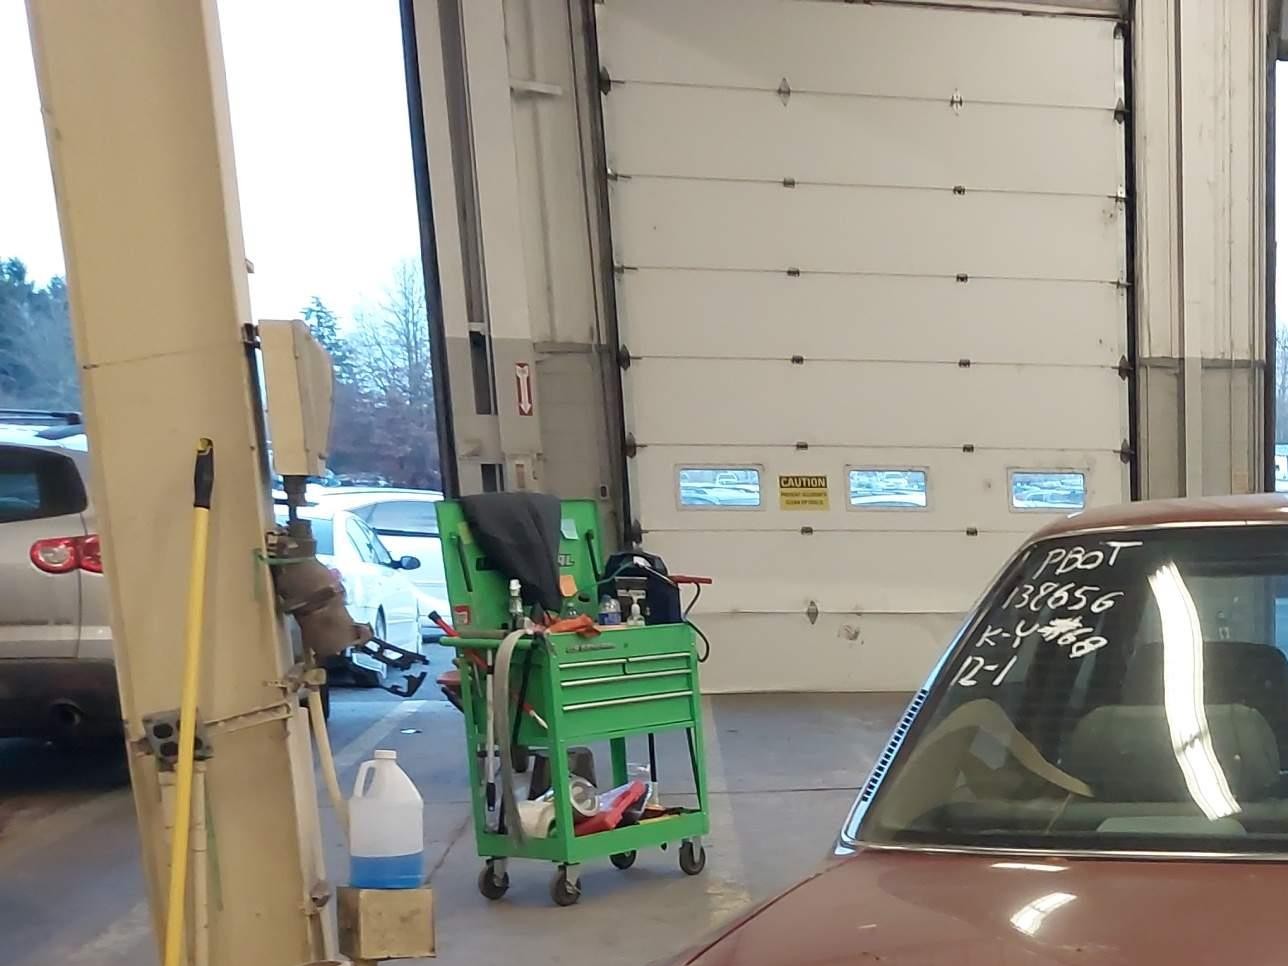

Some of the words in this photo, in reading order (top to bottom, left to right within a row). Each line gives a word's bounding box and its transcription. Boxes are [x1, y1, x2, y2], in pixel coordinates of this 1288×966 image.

[780, 477, 826, 488] CAUTION
[1031, 541, 1144, 580] PBOT
[1002, 582, 1125, 614] 138656
[950, 655, 1018, 687] 12-1
